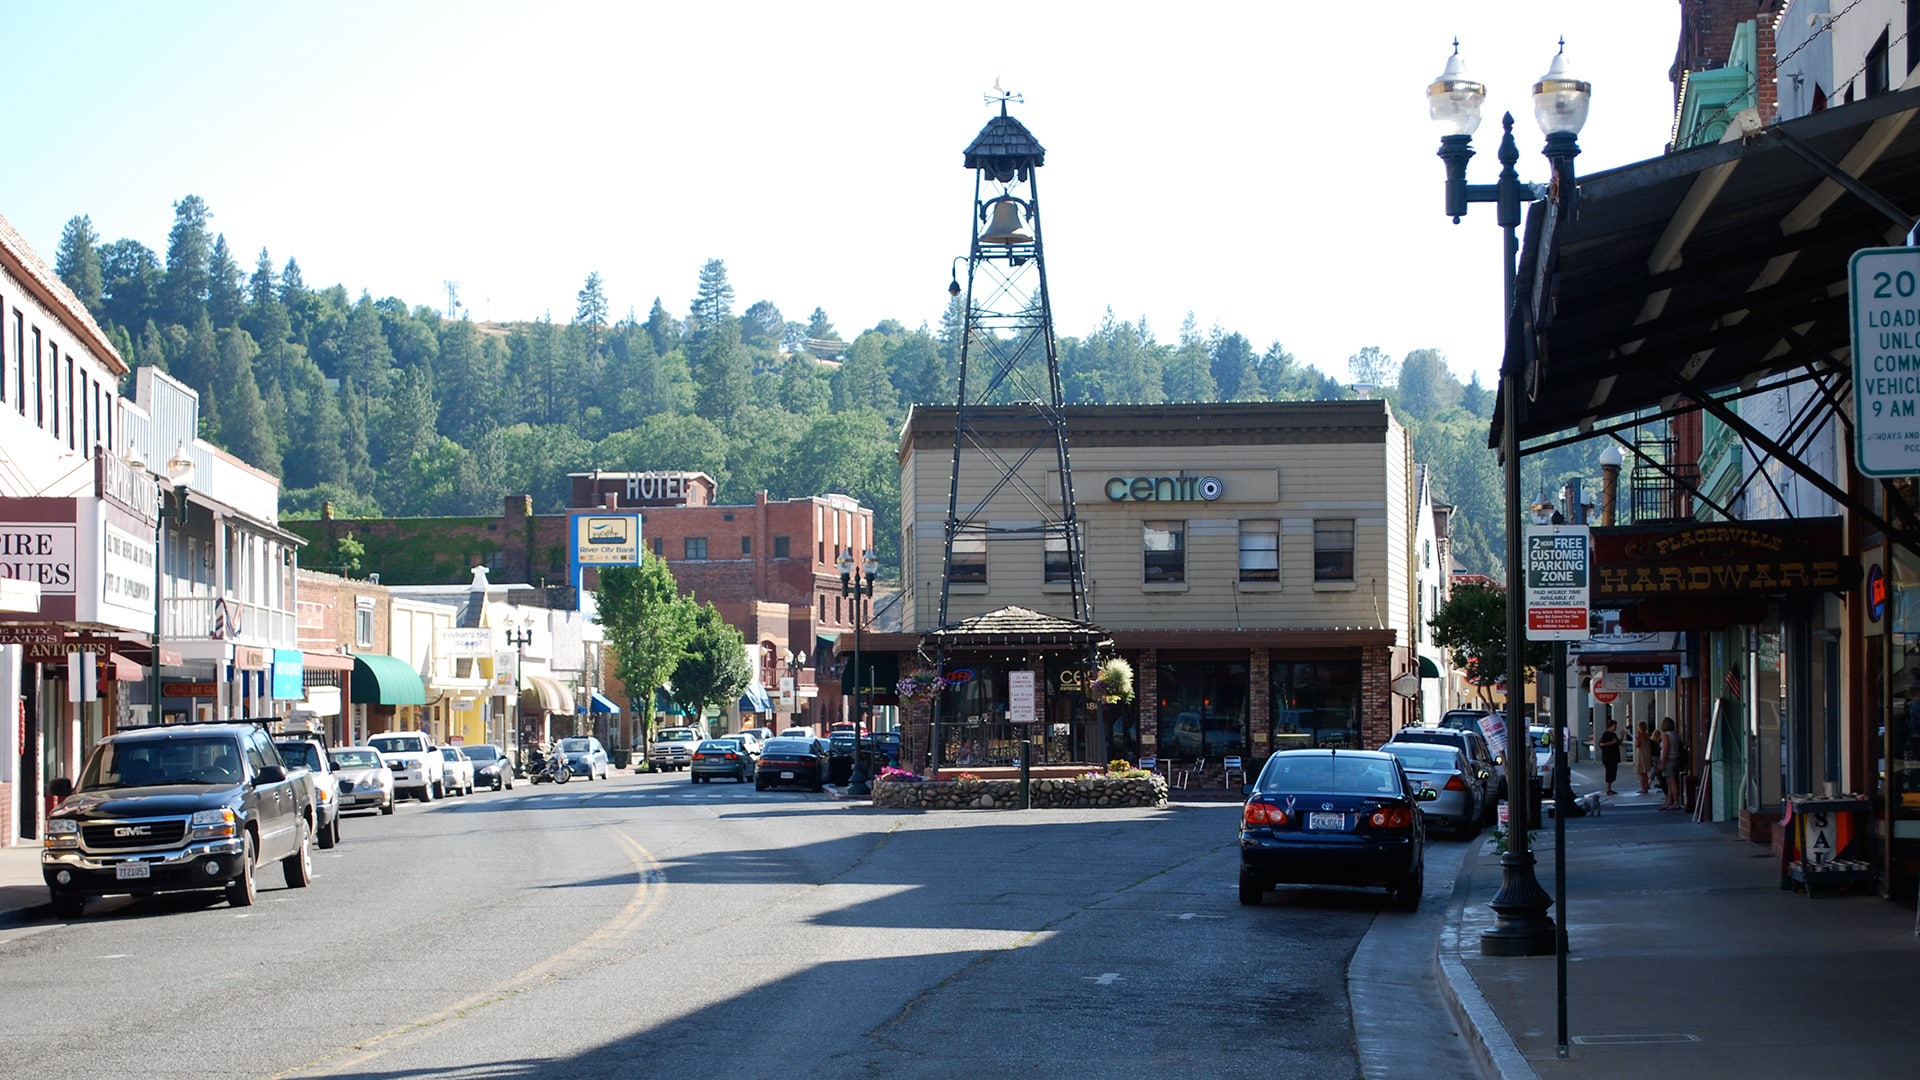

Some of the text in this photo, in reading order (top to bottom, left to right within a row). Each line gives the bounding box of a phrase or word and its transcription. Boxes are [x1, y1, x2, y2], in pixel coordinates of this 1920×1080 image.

[1873, 270, 1916, 298] 20
[1872, 400, 1914, 418] 9 AM
[1867, 432, 1903, 440] NDAYS
[626, 472, 687, 500] HOTEL
[1104, 470, 1223, 502] centro
[0, 533, 53, 556] IRE
[1532, 538, 1541, 549] 2
[1554, 537, 1583, 549] FREE
[1656, 527, 1783, 555] PLACERVILLE
[601, 546, 614, 554] City
[1530, 549, 1585, 561] CUSTOMER
[1531, 560, 1584, 571] PARKING
[1541, 571, 1574, 582] ZONE
[1600, 561, 1839, 593] HARDWARE
[1634, 676, 1666, 686] PLUS
[114, 825, 152, 837] GMC
